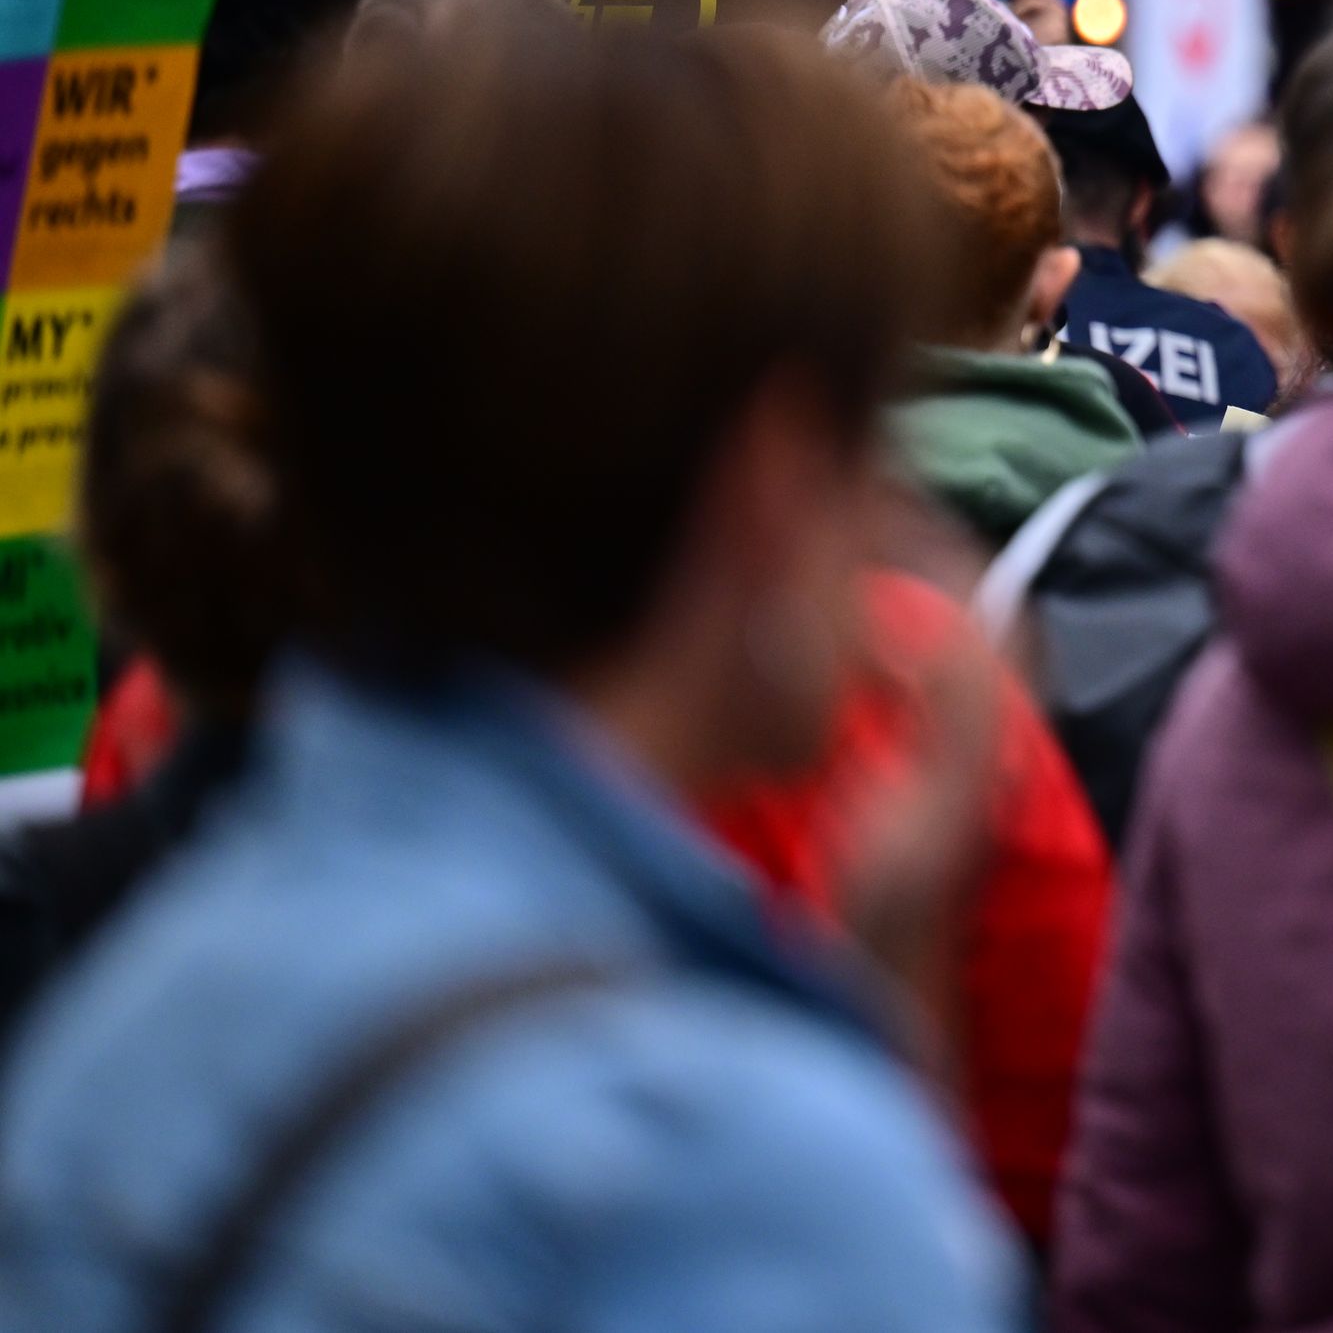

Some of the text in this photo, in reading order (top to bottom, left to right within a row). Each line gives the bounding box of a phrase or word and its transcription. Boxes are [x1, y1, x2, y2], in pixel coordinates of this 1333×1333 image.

[40, 133, 149, 182] gegen
[28, 189, 137, 231] rechts
[1088, 321, 1220, 405] IZEI
